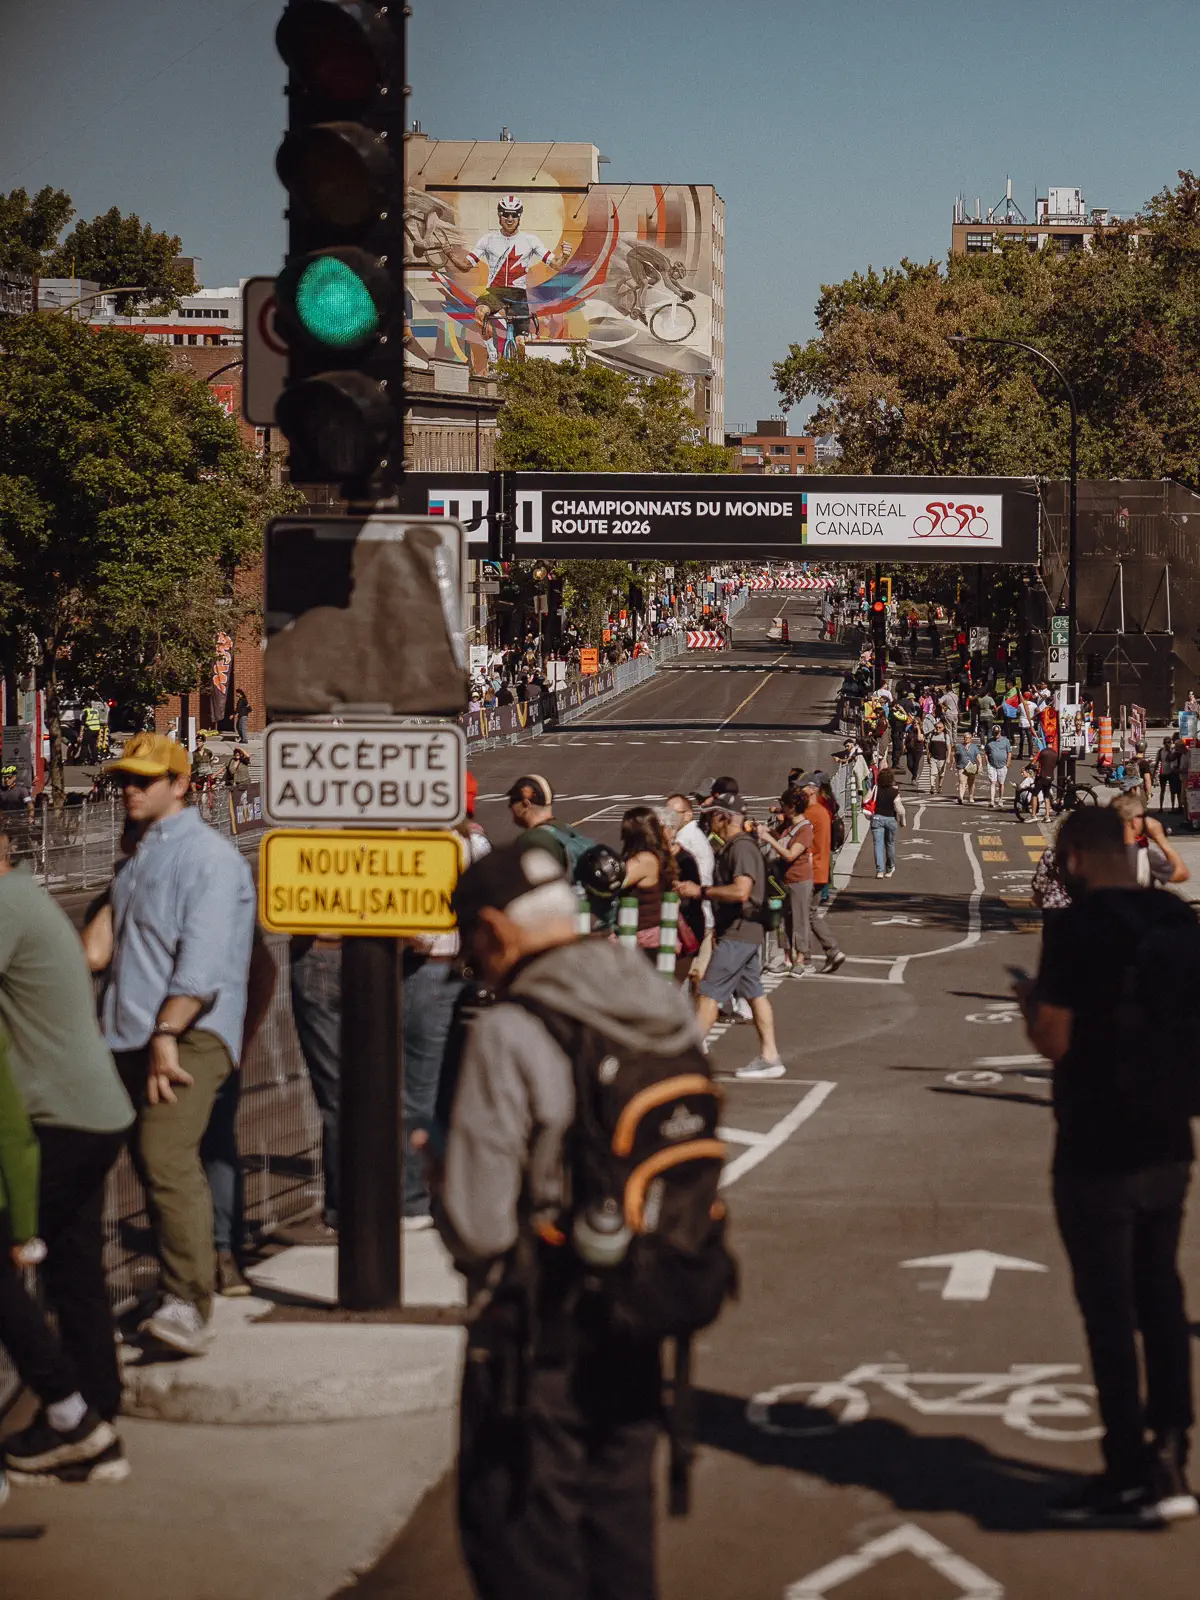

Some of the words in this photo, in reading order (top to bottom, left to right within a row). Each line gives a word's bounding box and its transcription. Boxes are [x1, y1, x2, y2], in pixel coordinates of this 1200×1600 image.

[551, 500, 692, 516] CHAMPIONNATS
[696, 502, 720, 516] DU
[725, 502, 793, 516] MONDE
[815, 500, 906, 517] MONTRÉAL
[551, 519, 608, 534] ROUTE
[612, 520, 651, 535] 2026
[815, 521, 884, 536] CANADA
[277, 780, 451, 807] AUTOBUS
[300, 848, 426, 877] NOUVELLE
[273, 886, 456, 914] SIGNALISATION
